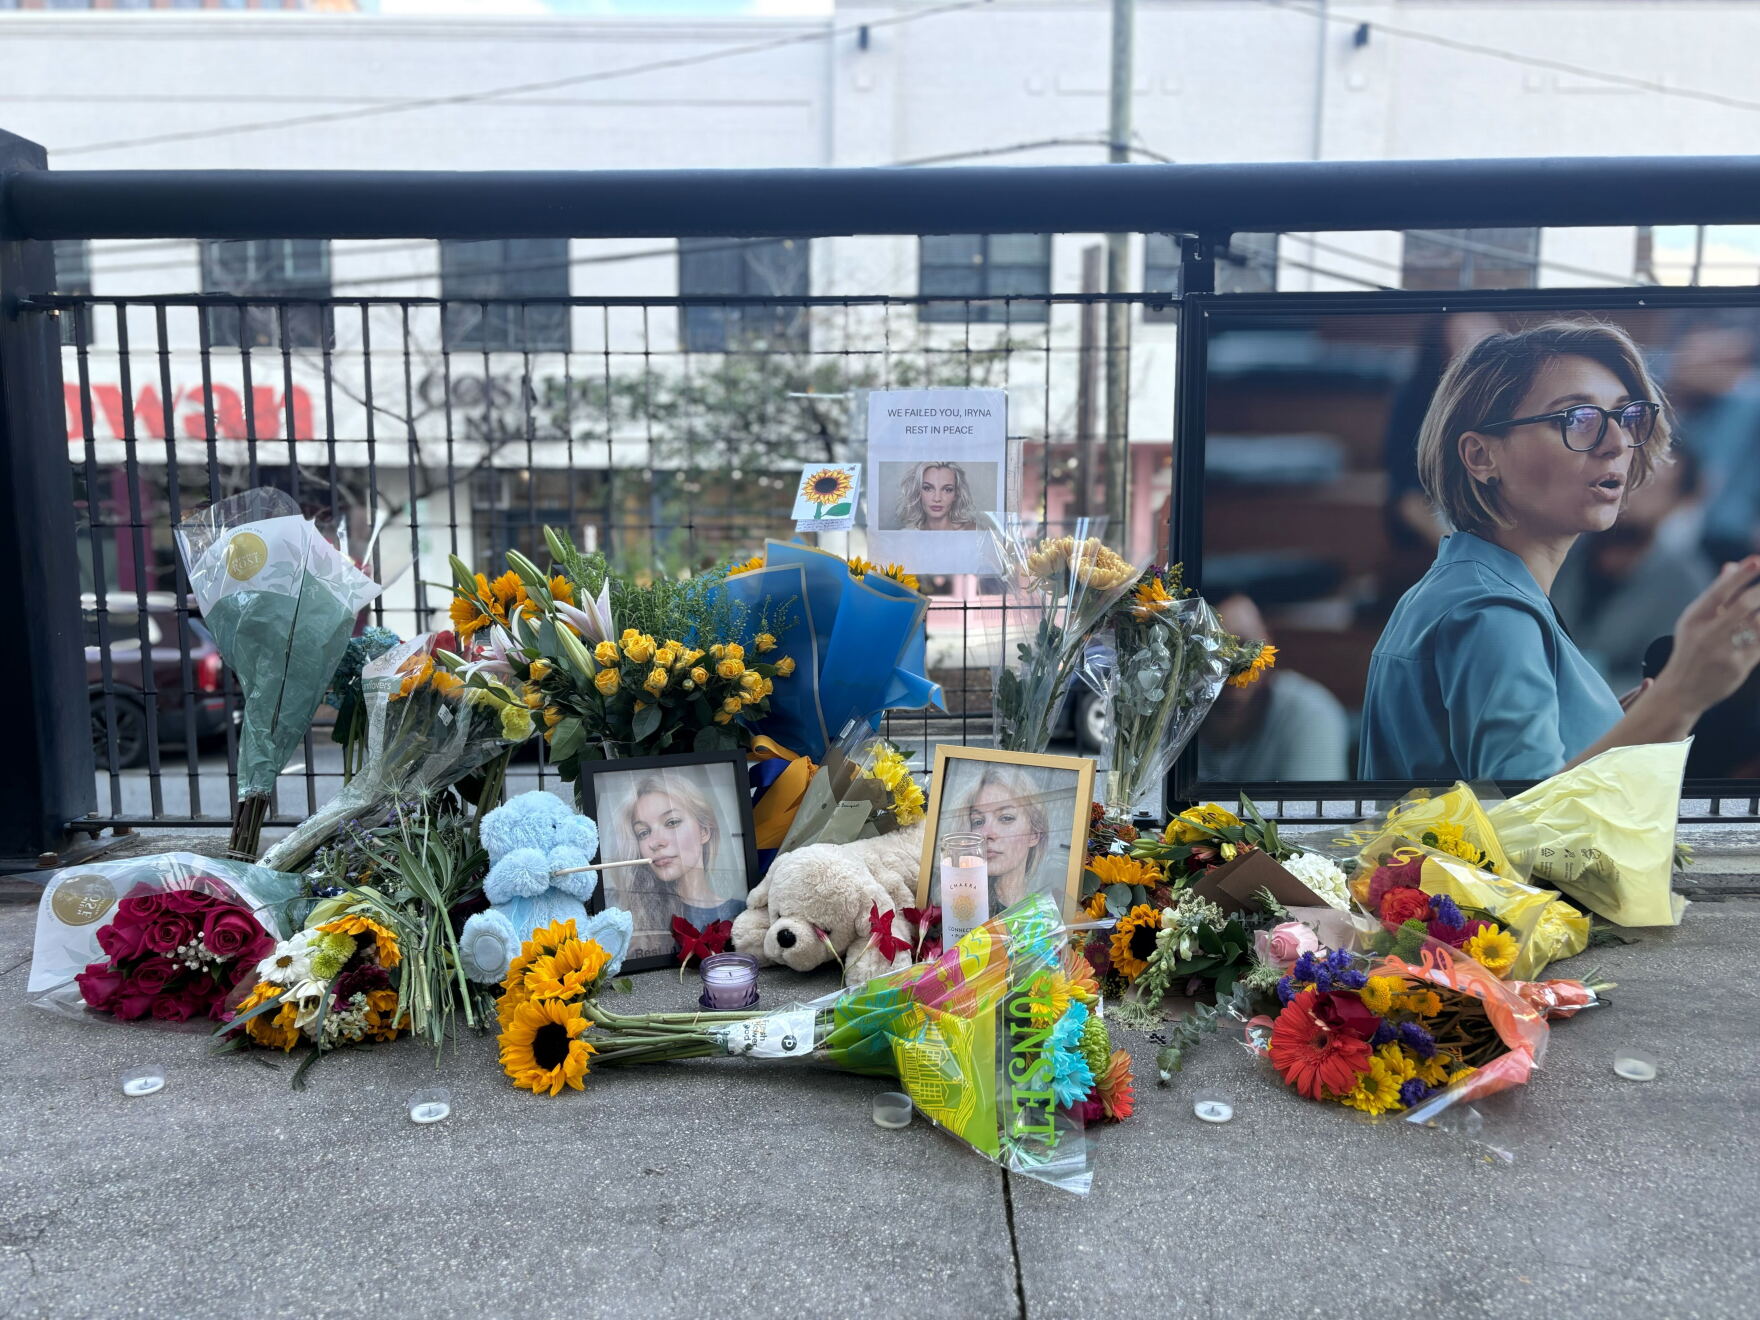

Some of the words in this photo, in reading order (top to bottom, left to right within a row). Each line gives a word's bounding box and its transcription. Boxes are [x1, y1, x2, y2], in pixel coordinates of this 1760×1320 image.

[887, 408, 902, 417] WE
[904, 408, 937, 417] FAILED
[939, 408, 962, 418] YOU,
[964, 408, 992, 417] IRYNA
[905, 425, 928, 434] REST
[930, 425, 941, 434] IN
[943, 425, 974, 434] PEACE
[949, 882, 977, 890] CHAKRA
[1009, 970, 1056, 1146] SUNSET
